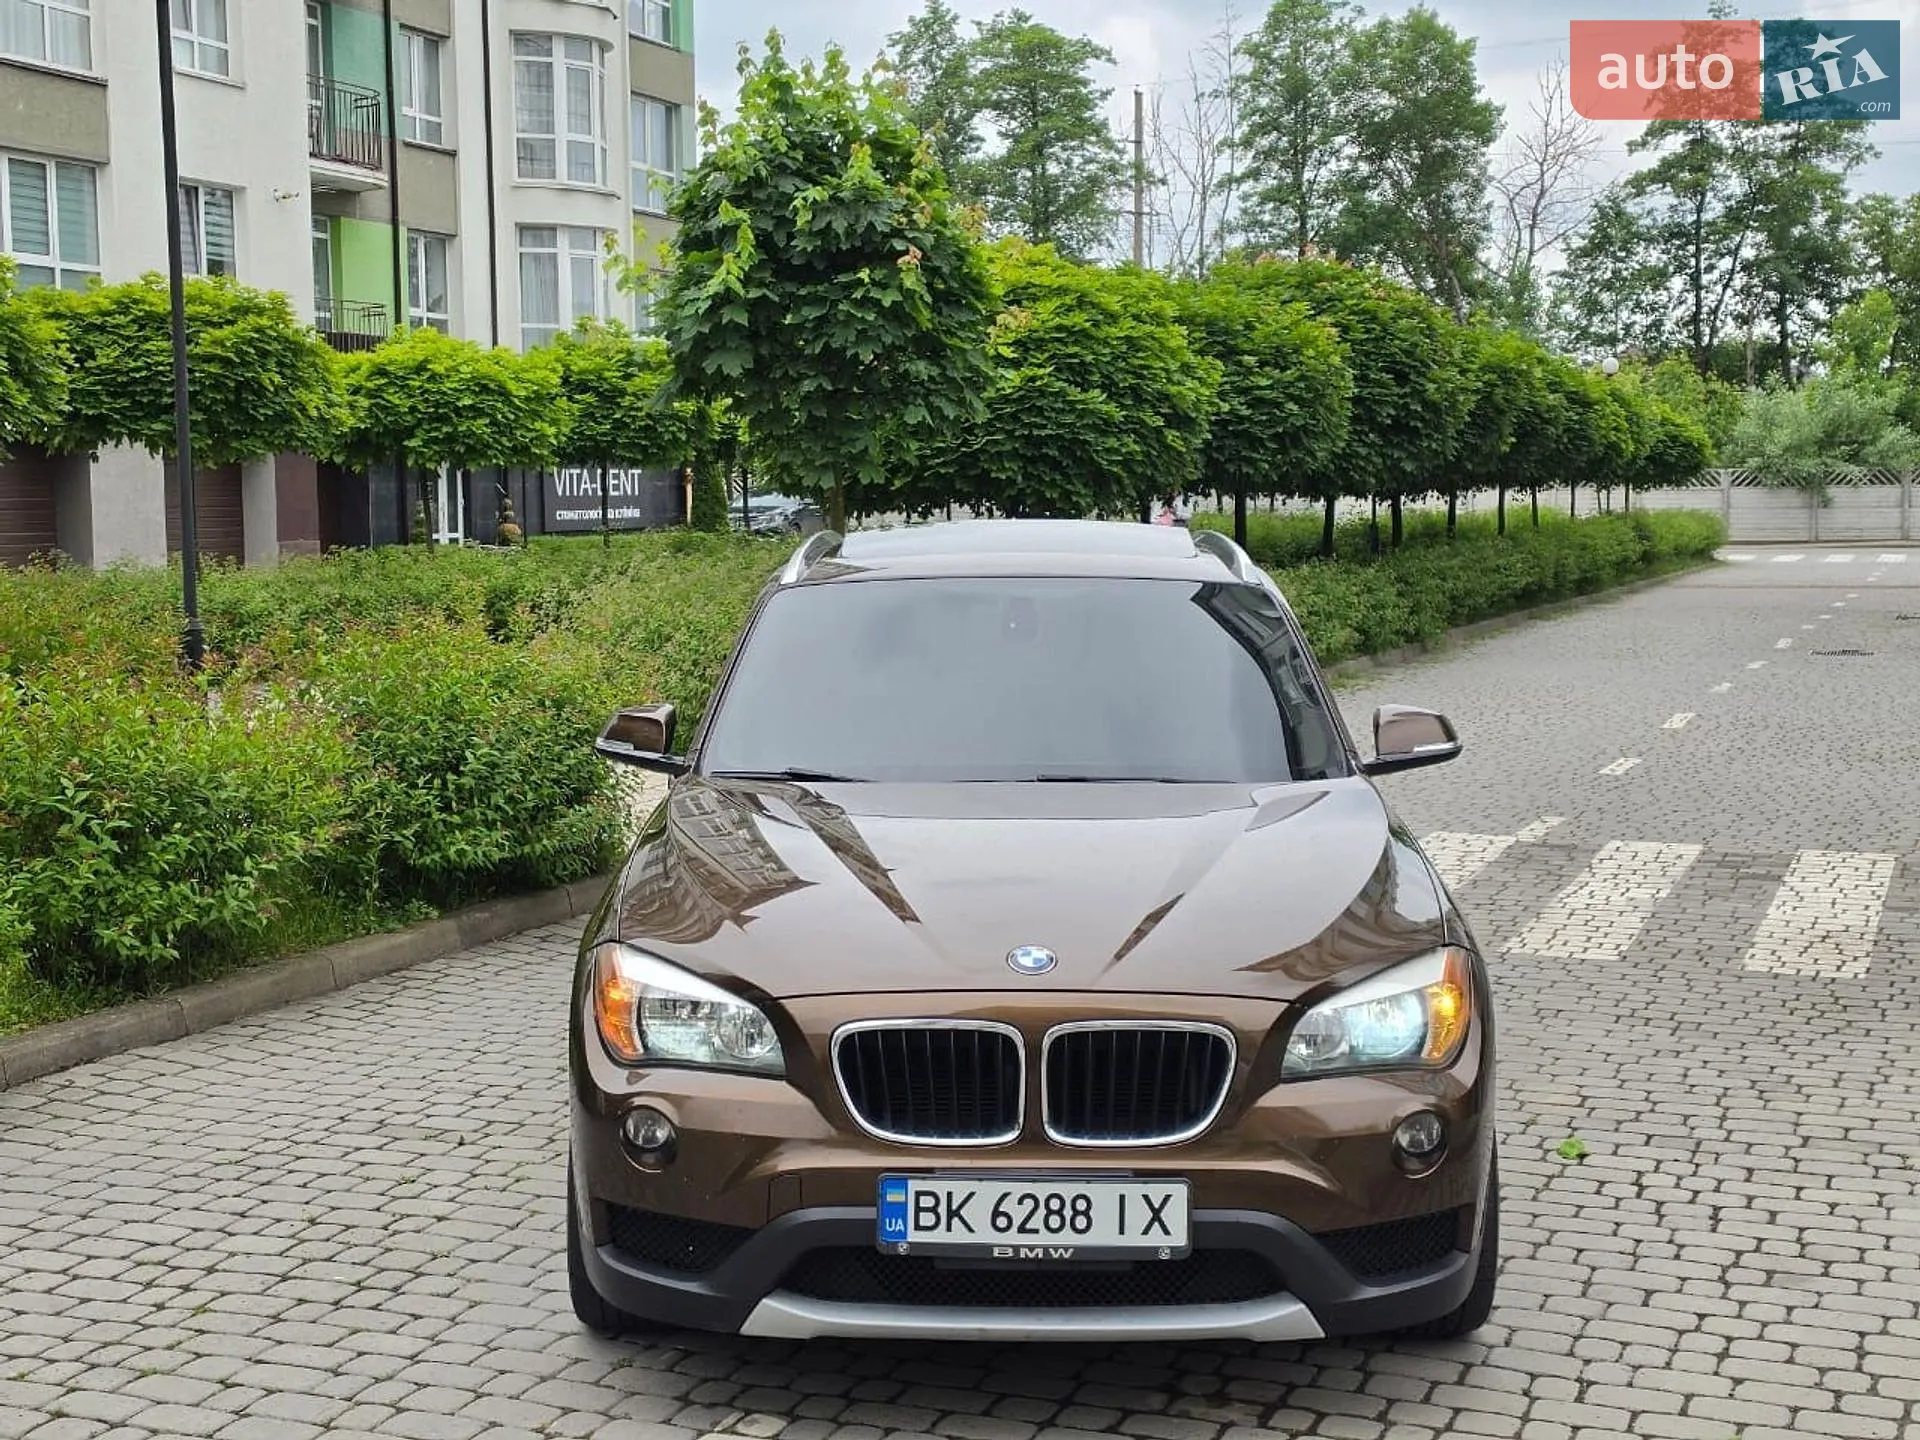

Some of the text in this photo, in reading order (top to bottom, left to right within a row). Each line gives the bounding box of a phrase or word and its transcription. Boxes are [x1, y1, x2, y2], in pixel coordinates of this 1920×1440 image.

[913, 1190, 1173, 1236] BK 6288 IX
[886, 1218, 905, 1233] UA
[992, 1246, 1074, 1259] BMW
